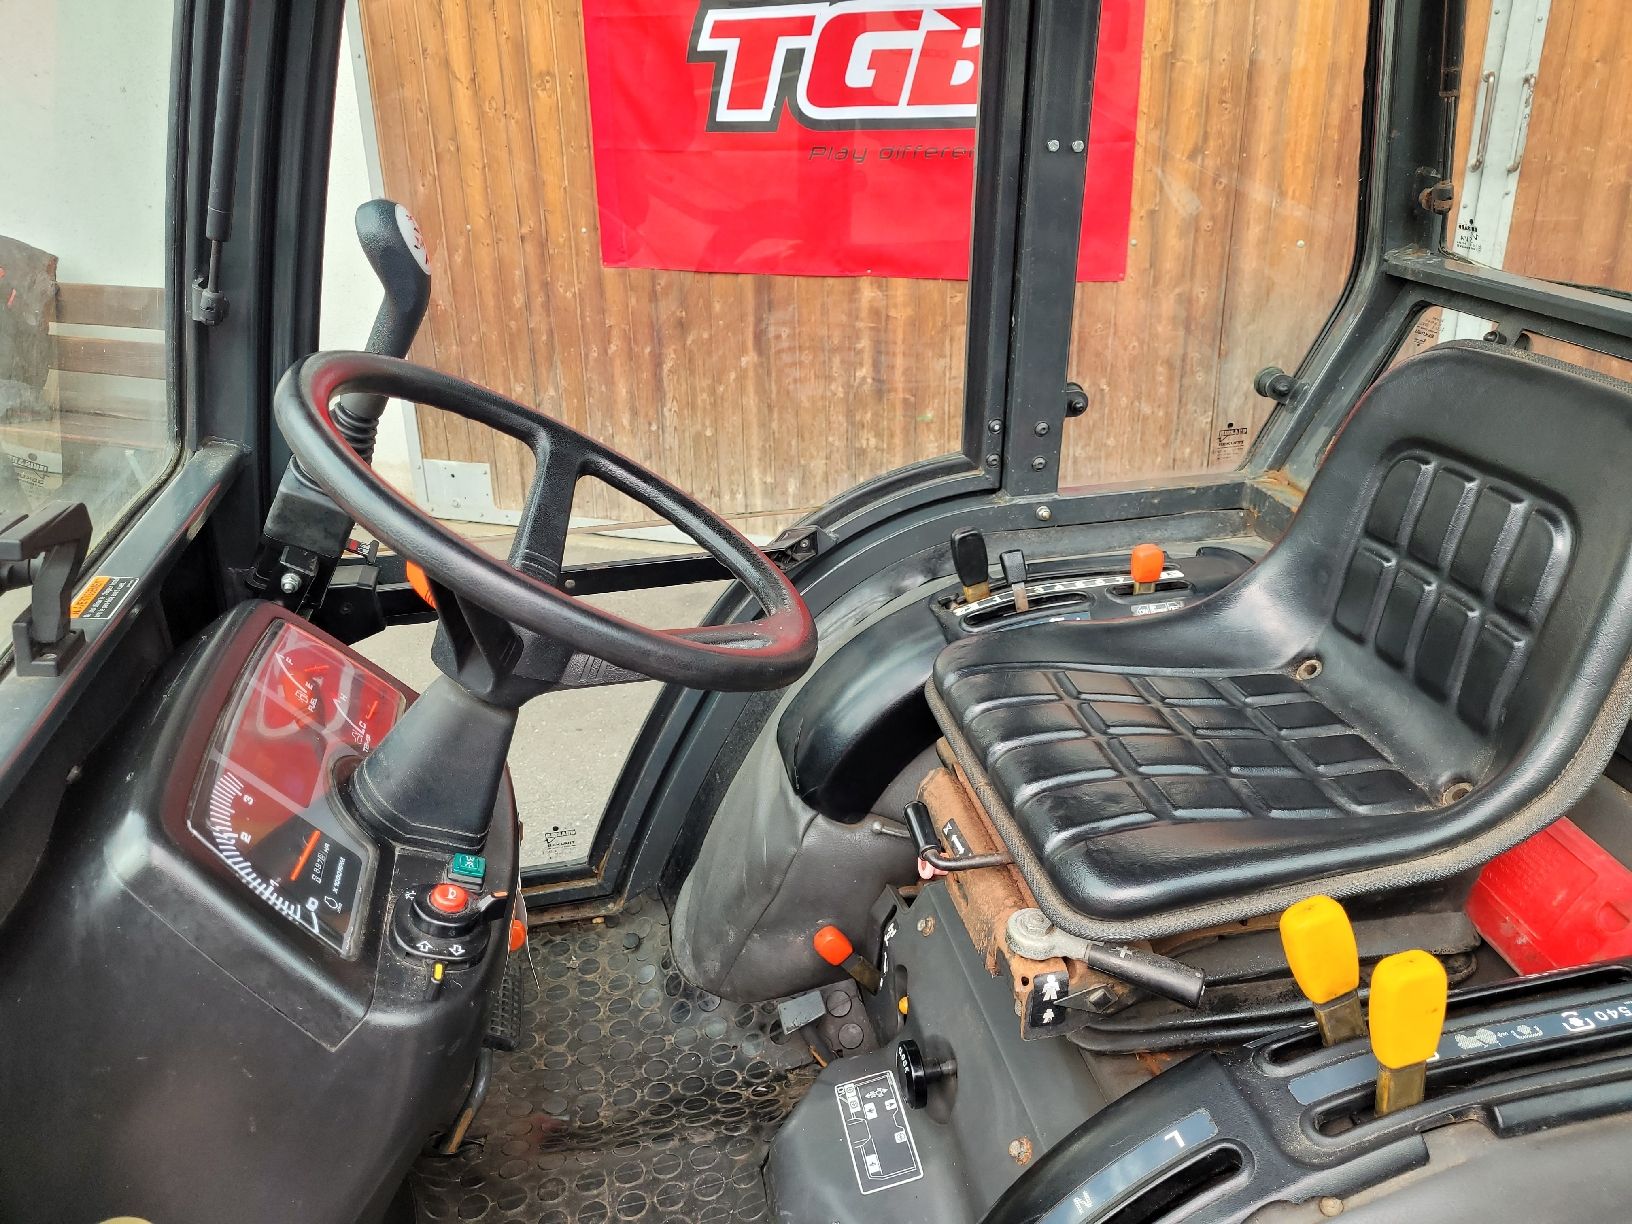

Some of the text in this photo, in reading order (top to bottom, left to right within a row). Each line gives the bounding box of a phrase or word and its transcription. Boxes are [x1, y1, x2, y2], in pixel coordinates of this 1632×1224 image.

[697, 2, 982, 122] TGB
[808, 146, 867, 163] Play
[339, 692, 347, 702] H
[243, 794, 254, 806] 3
[240, 831, 252, 844] 2
[306, 896, 319, 912] 0
[1595, 1006, 1632, 1022] 540
[1073, 1191, 1094, 1215] N
